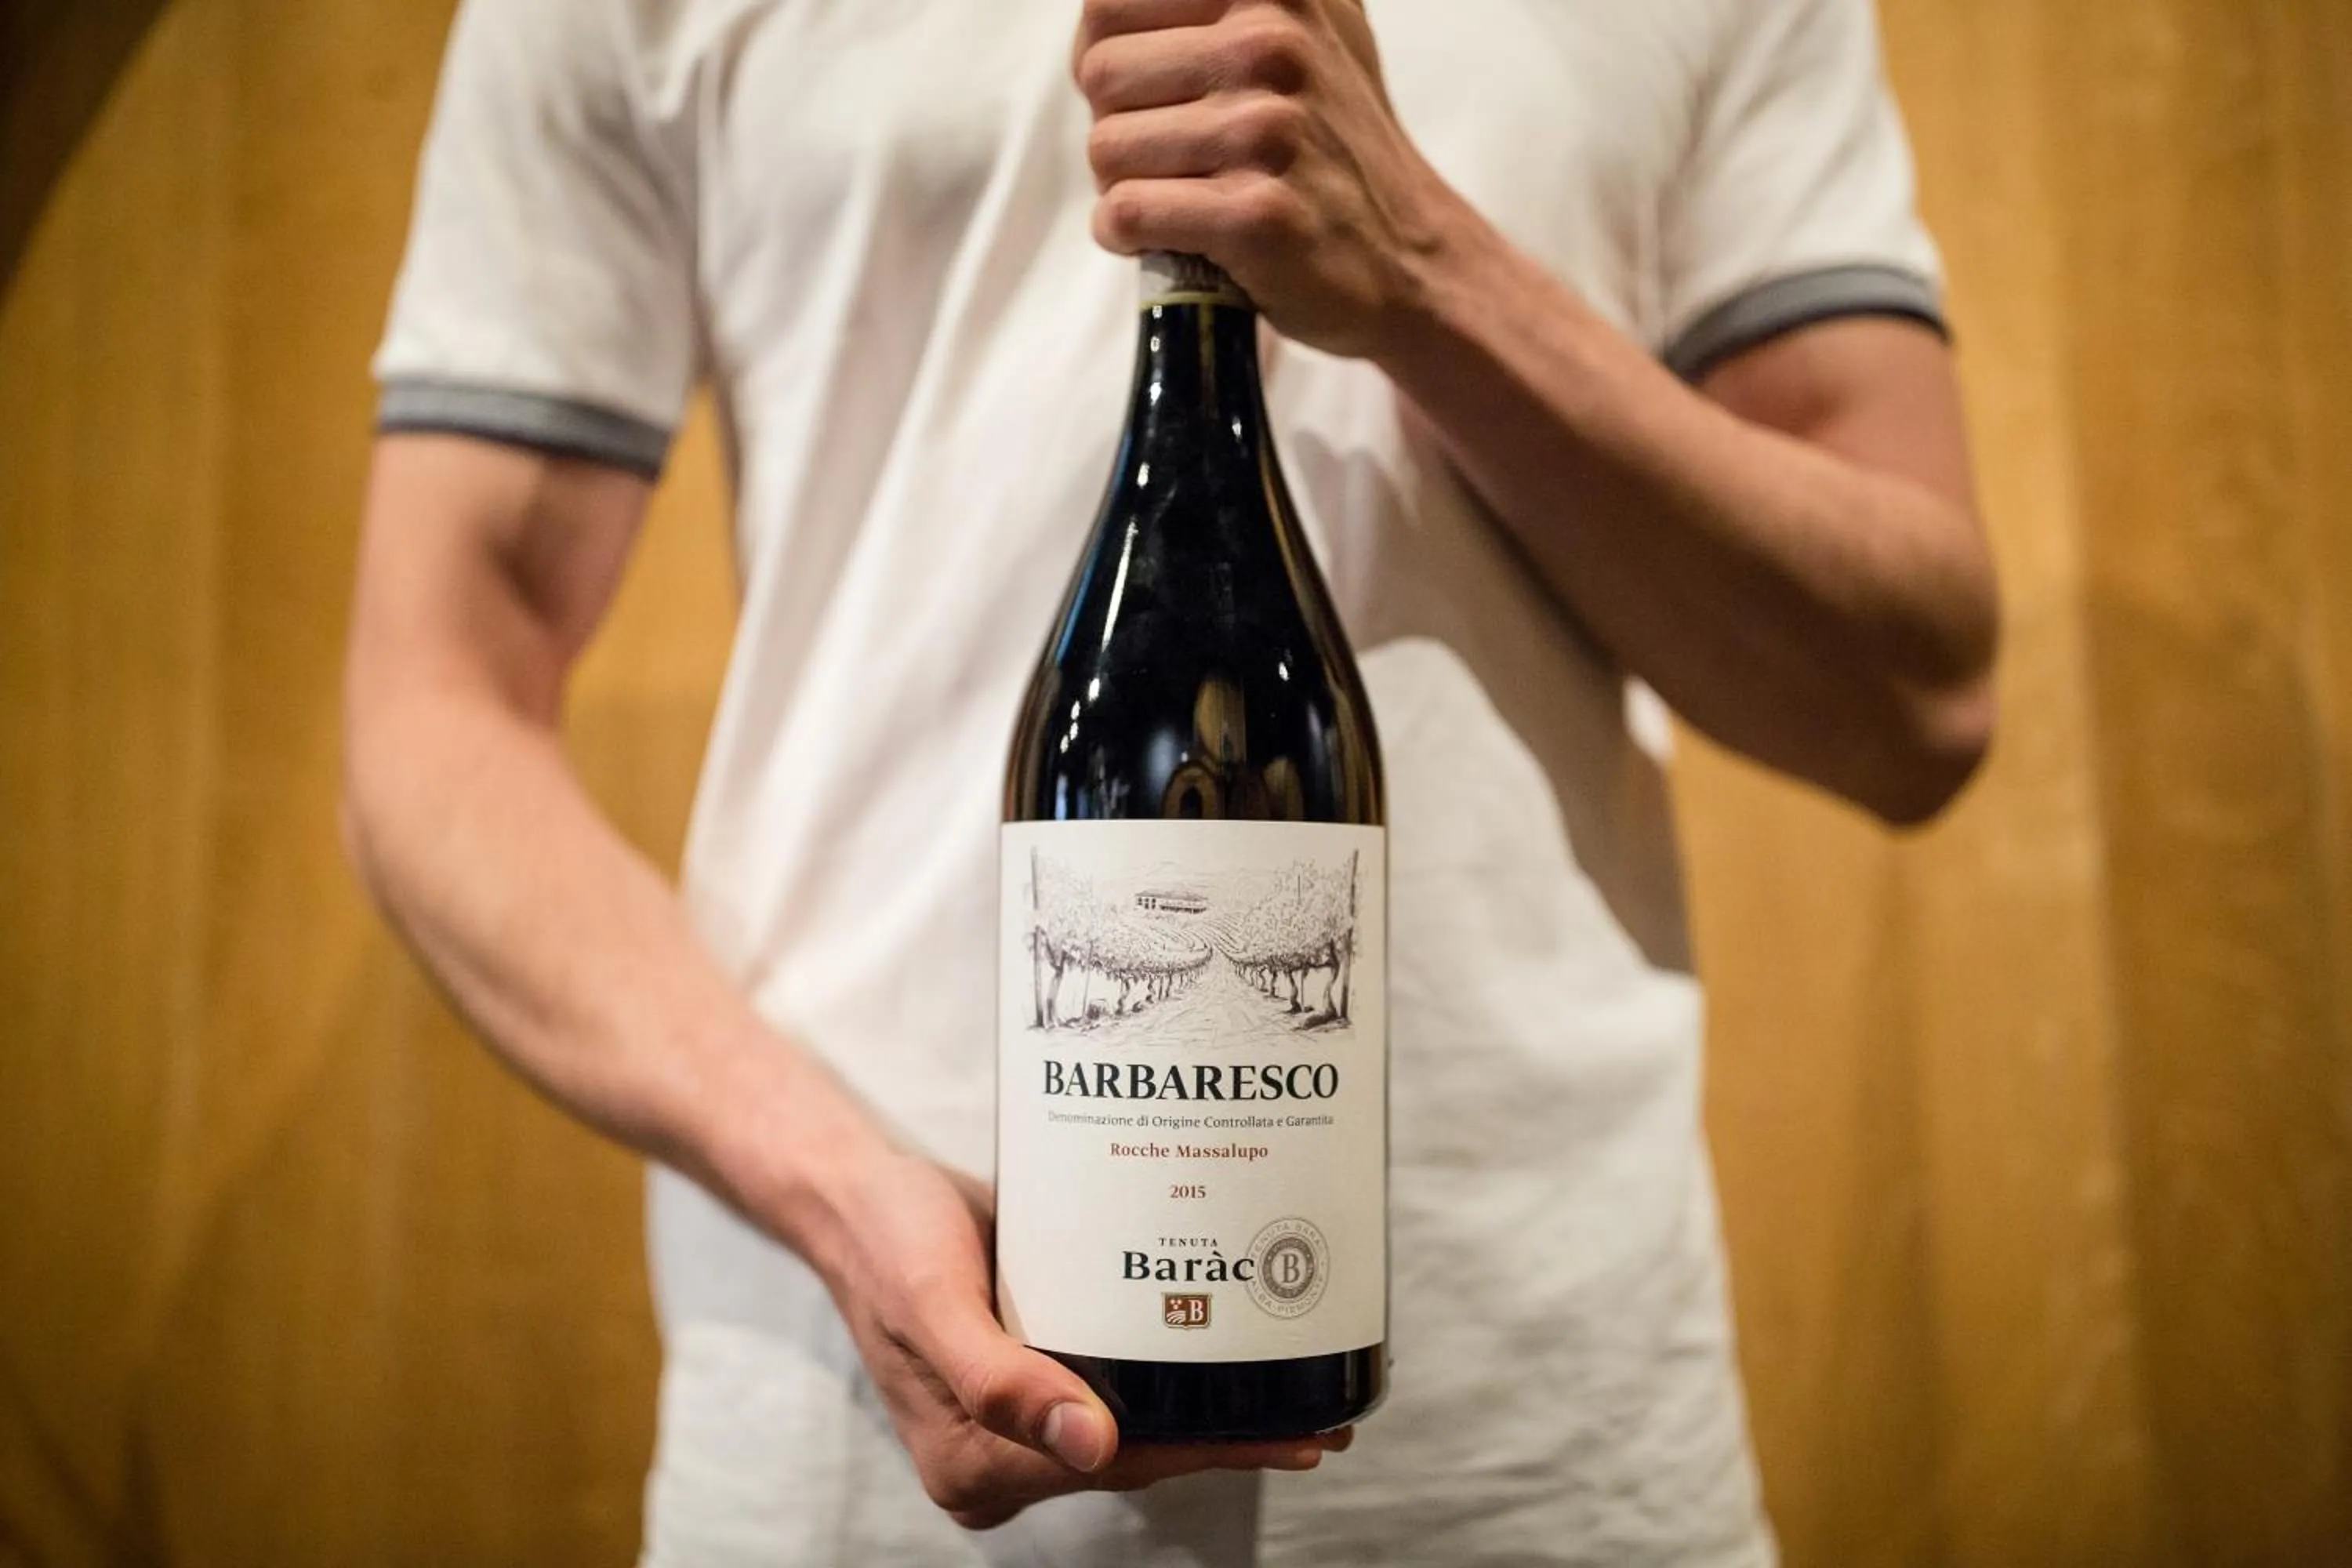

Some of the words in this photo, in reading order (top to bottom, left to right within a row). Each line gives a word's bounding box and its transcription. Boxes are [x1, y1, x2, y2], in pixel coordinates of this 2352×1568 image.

[1044, 1060, 1339, 1101] BARBARESCO
[1048, 1110, 1134, 1127] Denominazione
[1137, 1115, 1149, 1127] di
[1152, 1116, 1201, 1131] Origine
[1203, 1116, 1274, 1128] Controllata
[1276, 1119, 1283, 1127] e
[1286, 1115, 1334, 1127] Garantita
[1110, 1142, 1171, 1158] Rocche
[1175, 1142, 1269, 1162] Massalupo
[1170, 1185, 1207, 1200] 2015
[1158, 1237, 1218, 1247] TENUTA
[1122, 1250, 1255, 1282] Baràc
[1281, 1254, 1301, 1283] B
[1188, 1299, 1204, 1323] B
